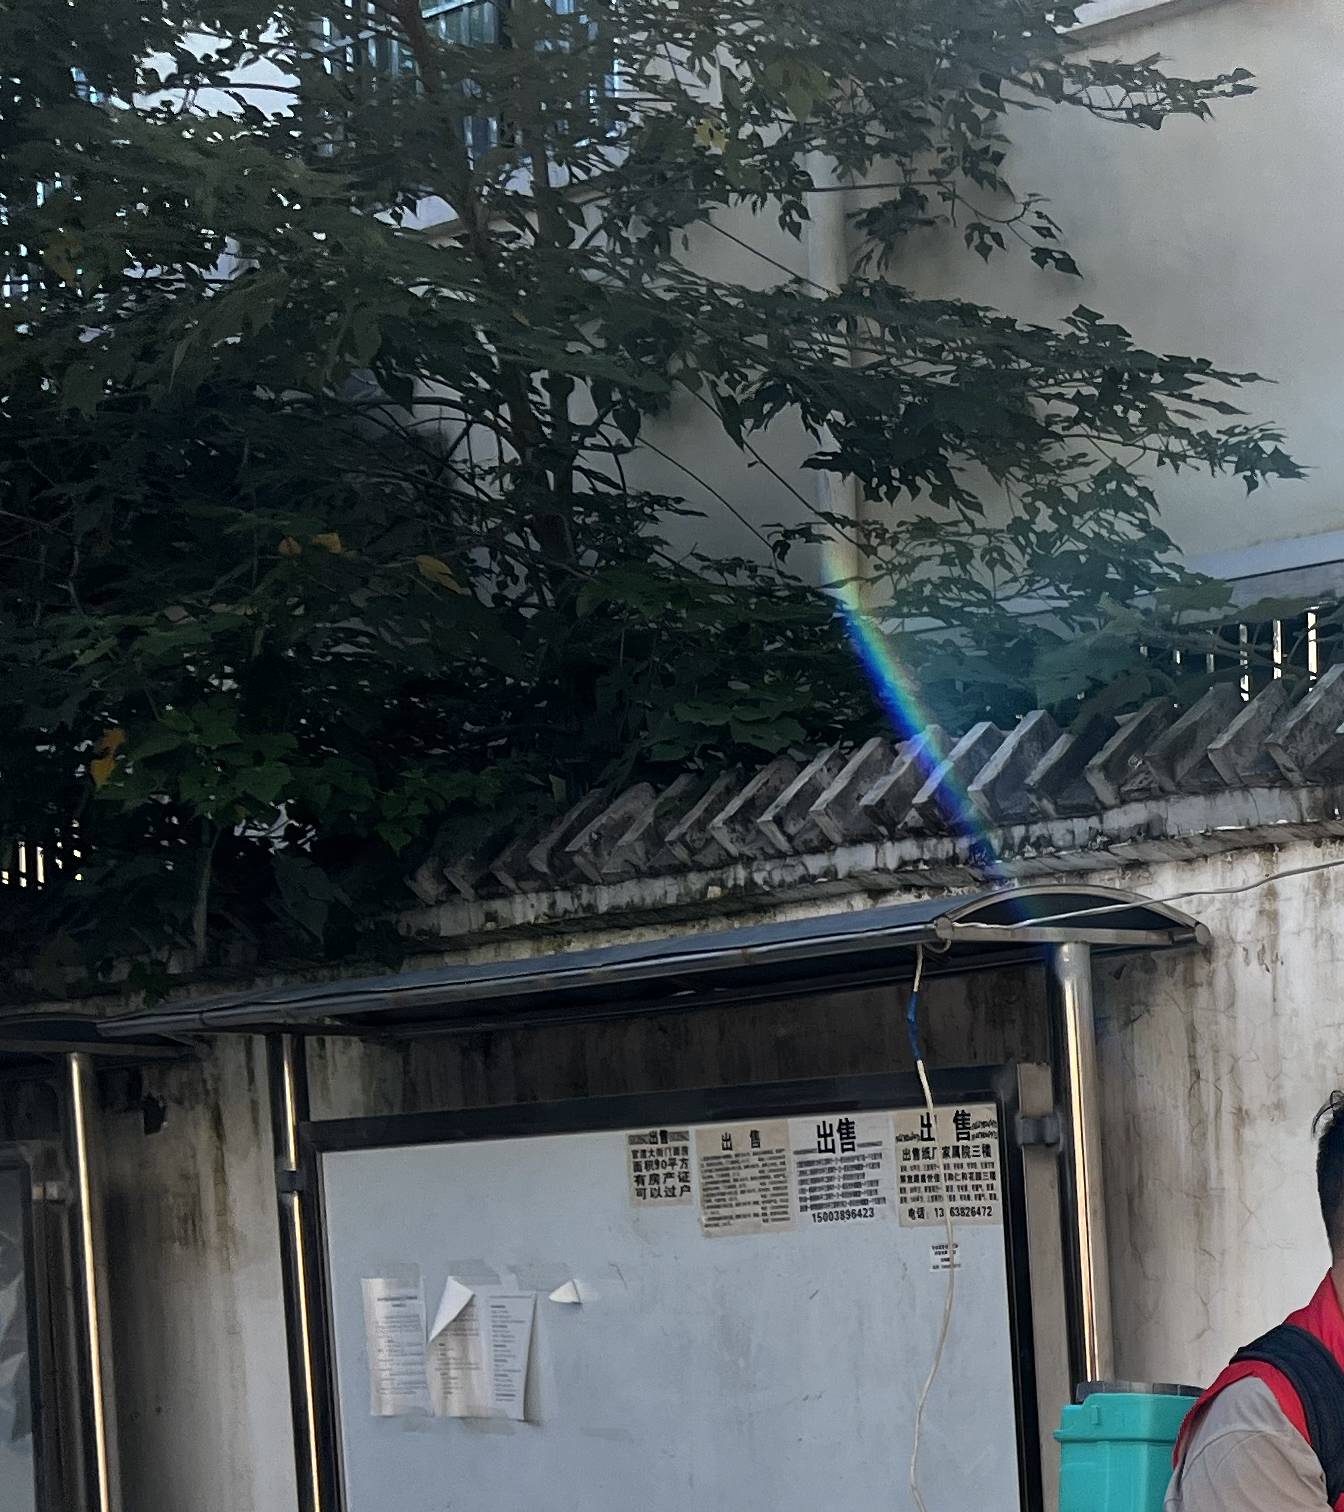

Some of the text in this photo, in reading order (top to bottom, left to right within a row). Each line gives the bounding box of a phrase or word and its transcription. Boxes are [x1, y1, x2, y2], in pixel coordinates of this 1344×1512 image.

[816, 1117, 857, 1154] 出售
[634, 1171, 691, 1186] 有房产证
[636, 1185, 691, 1200] 可以过户
